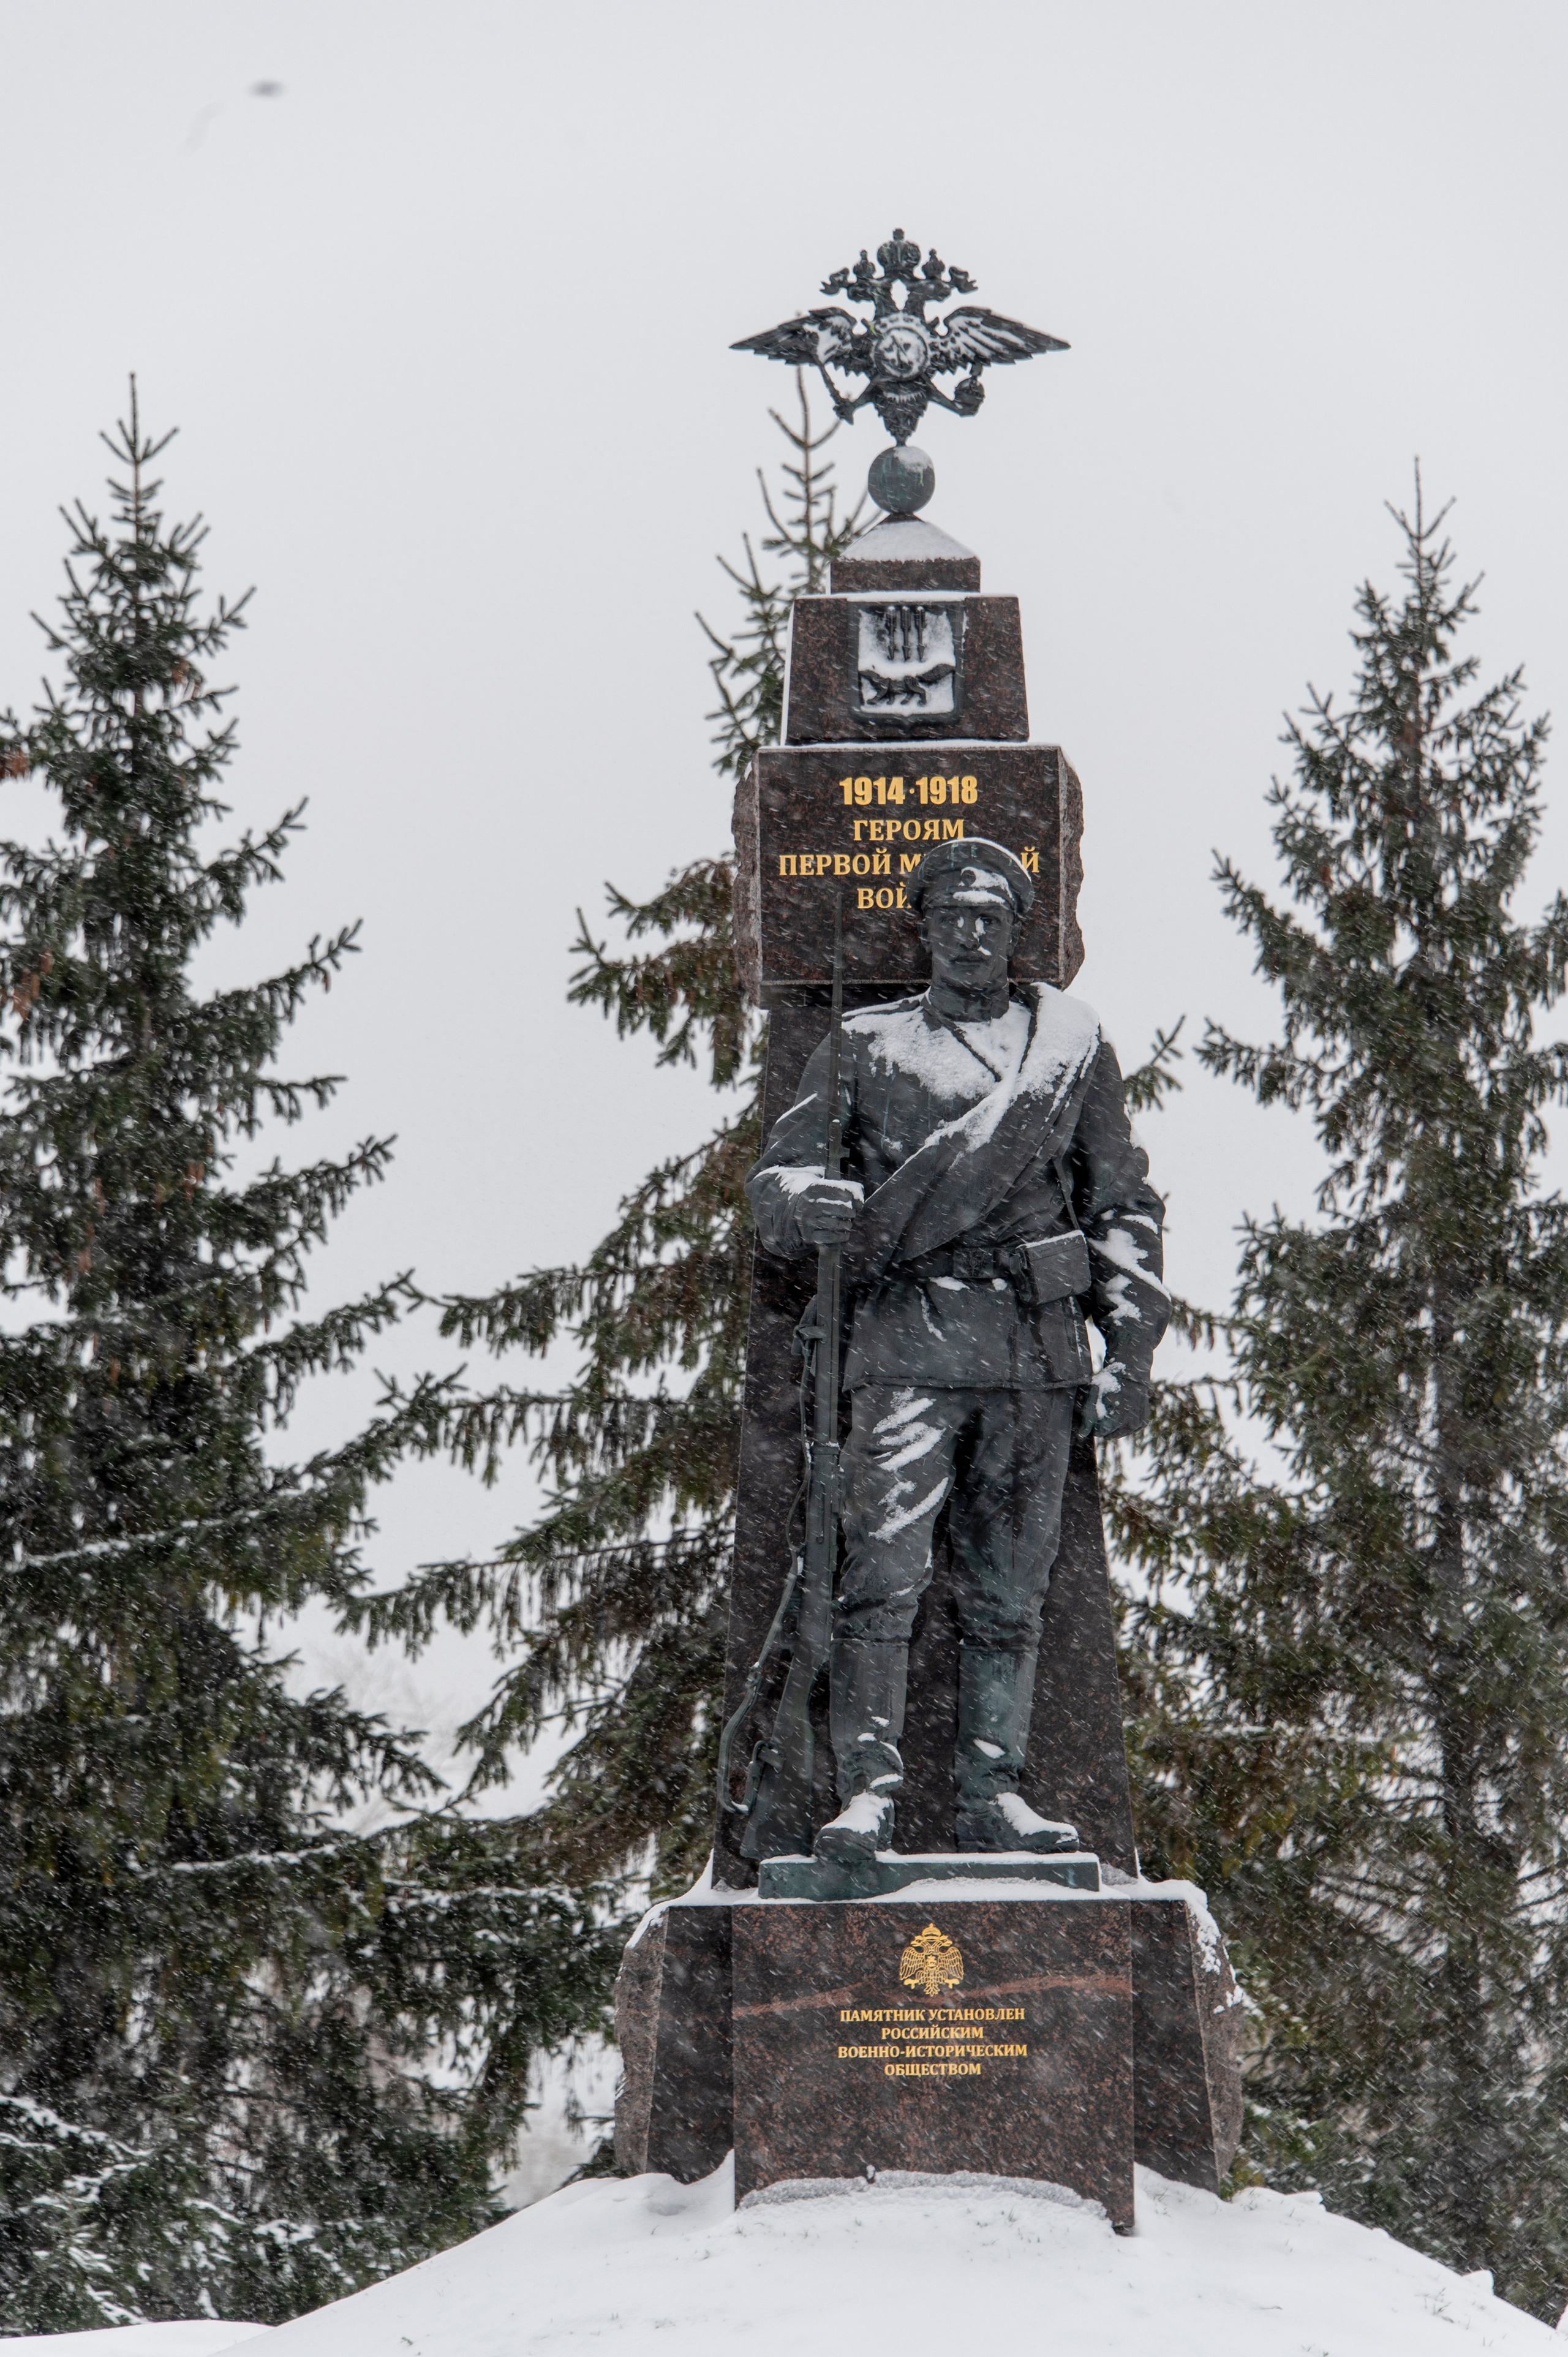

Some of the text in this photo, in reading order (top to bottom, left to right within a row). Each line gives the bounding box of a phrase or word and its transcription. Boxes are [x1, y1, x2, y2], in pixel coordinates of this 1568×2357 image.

[853, 818, 965, 842] ГЕРОЯМ
[778, 847, 892, 876] ПЕРВОЙ
[856, 881, 913, 909] ВОЙ
[840, 2007, 1026, 2022] ПАМЯТНИК УСТАНОВЛЕН
[881, 2024, 985, 2040] РОССИЙСКИМ
[837, 2043, 1028, 2059] ВОЕННО-ИСТОРИЧЕСКИМ
[884, 2062, 982, 2078] ОБЩЕСТВОМ
